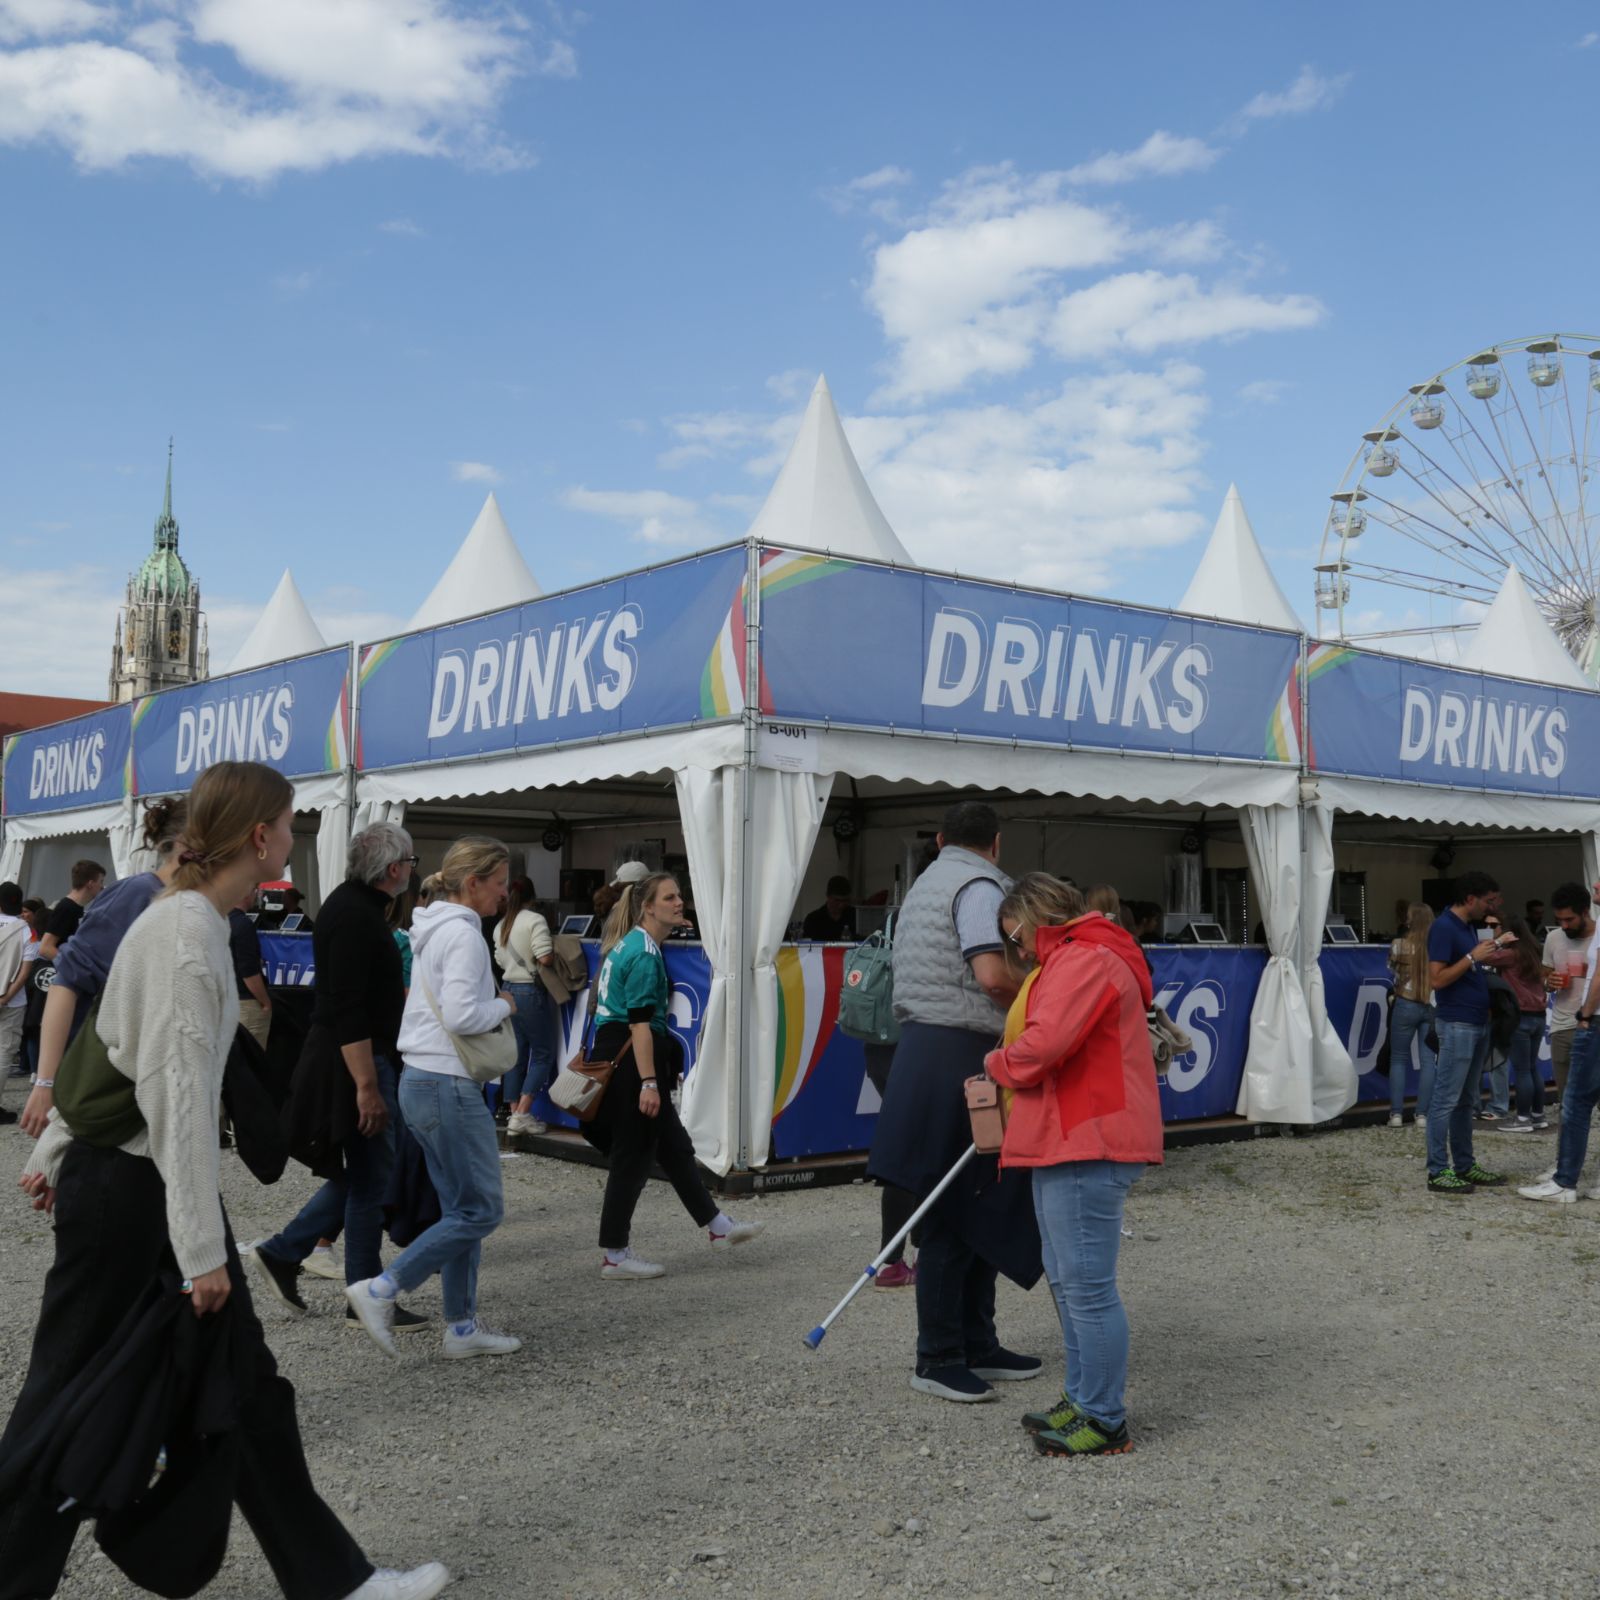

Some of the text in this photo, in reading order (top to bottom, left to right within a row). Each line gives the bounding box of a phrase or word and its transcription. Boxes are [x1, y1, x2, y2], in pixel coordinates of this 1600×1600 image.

[427, 602, 645, 739] DRINKS
[921, 606, 1214, 735] DRINKS
[29, 728, 107, 801] DRINKS
[175, 681, 295, 775] DRINKS
[1399, 683, 1570, 779] DRINKS
[765, 1172, 815, 1186] KORTKAMP
